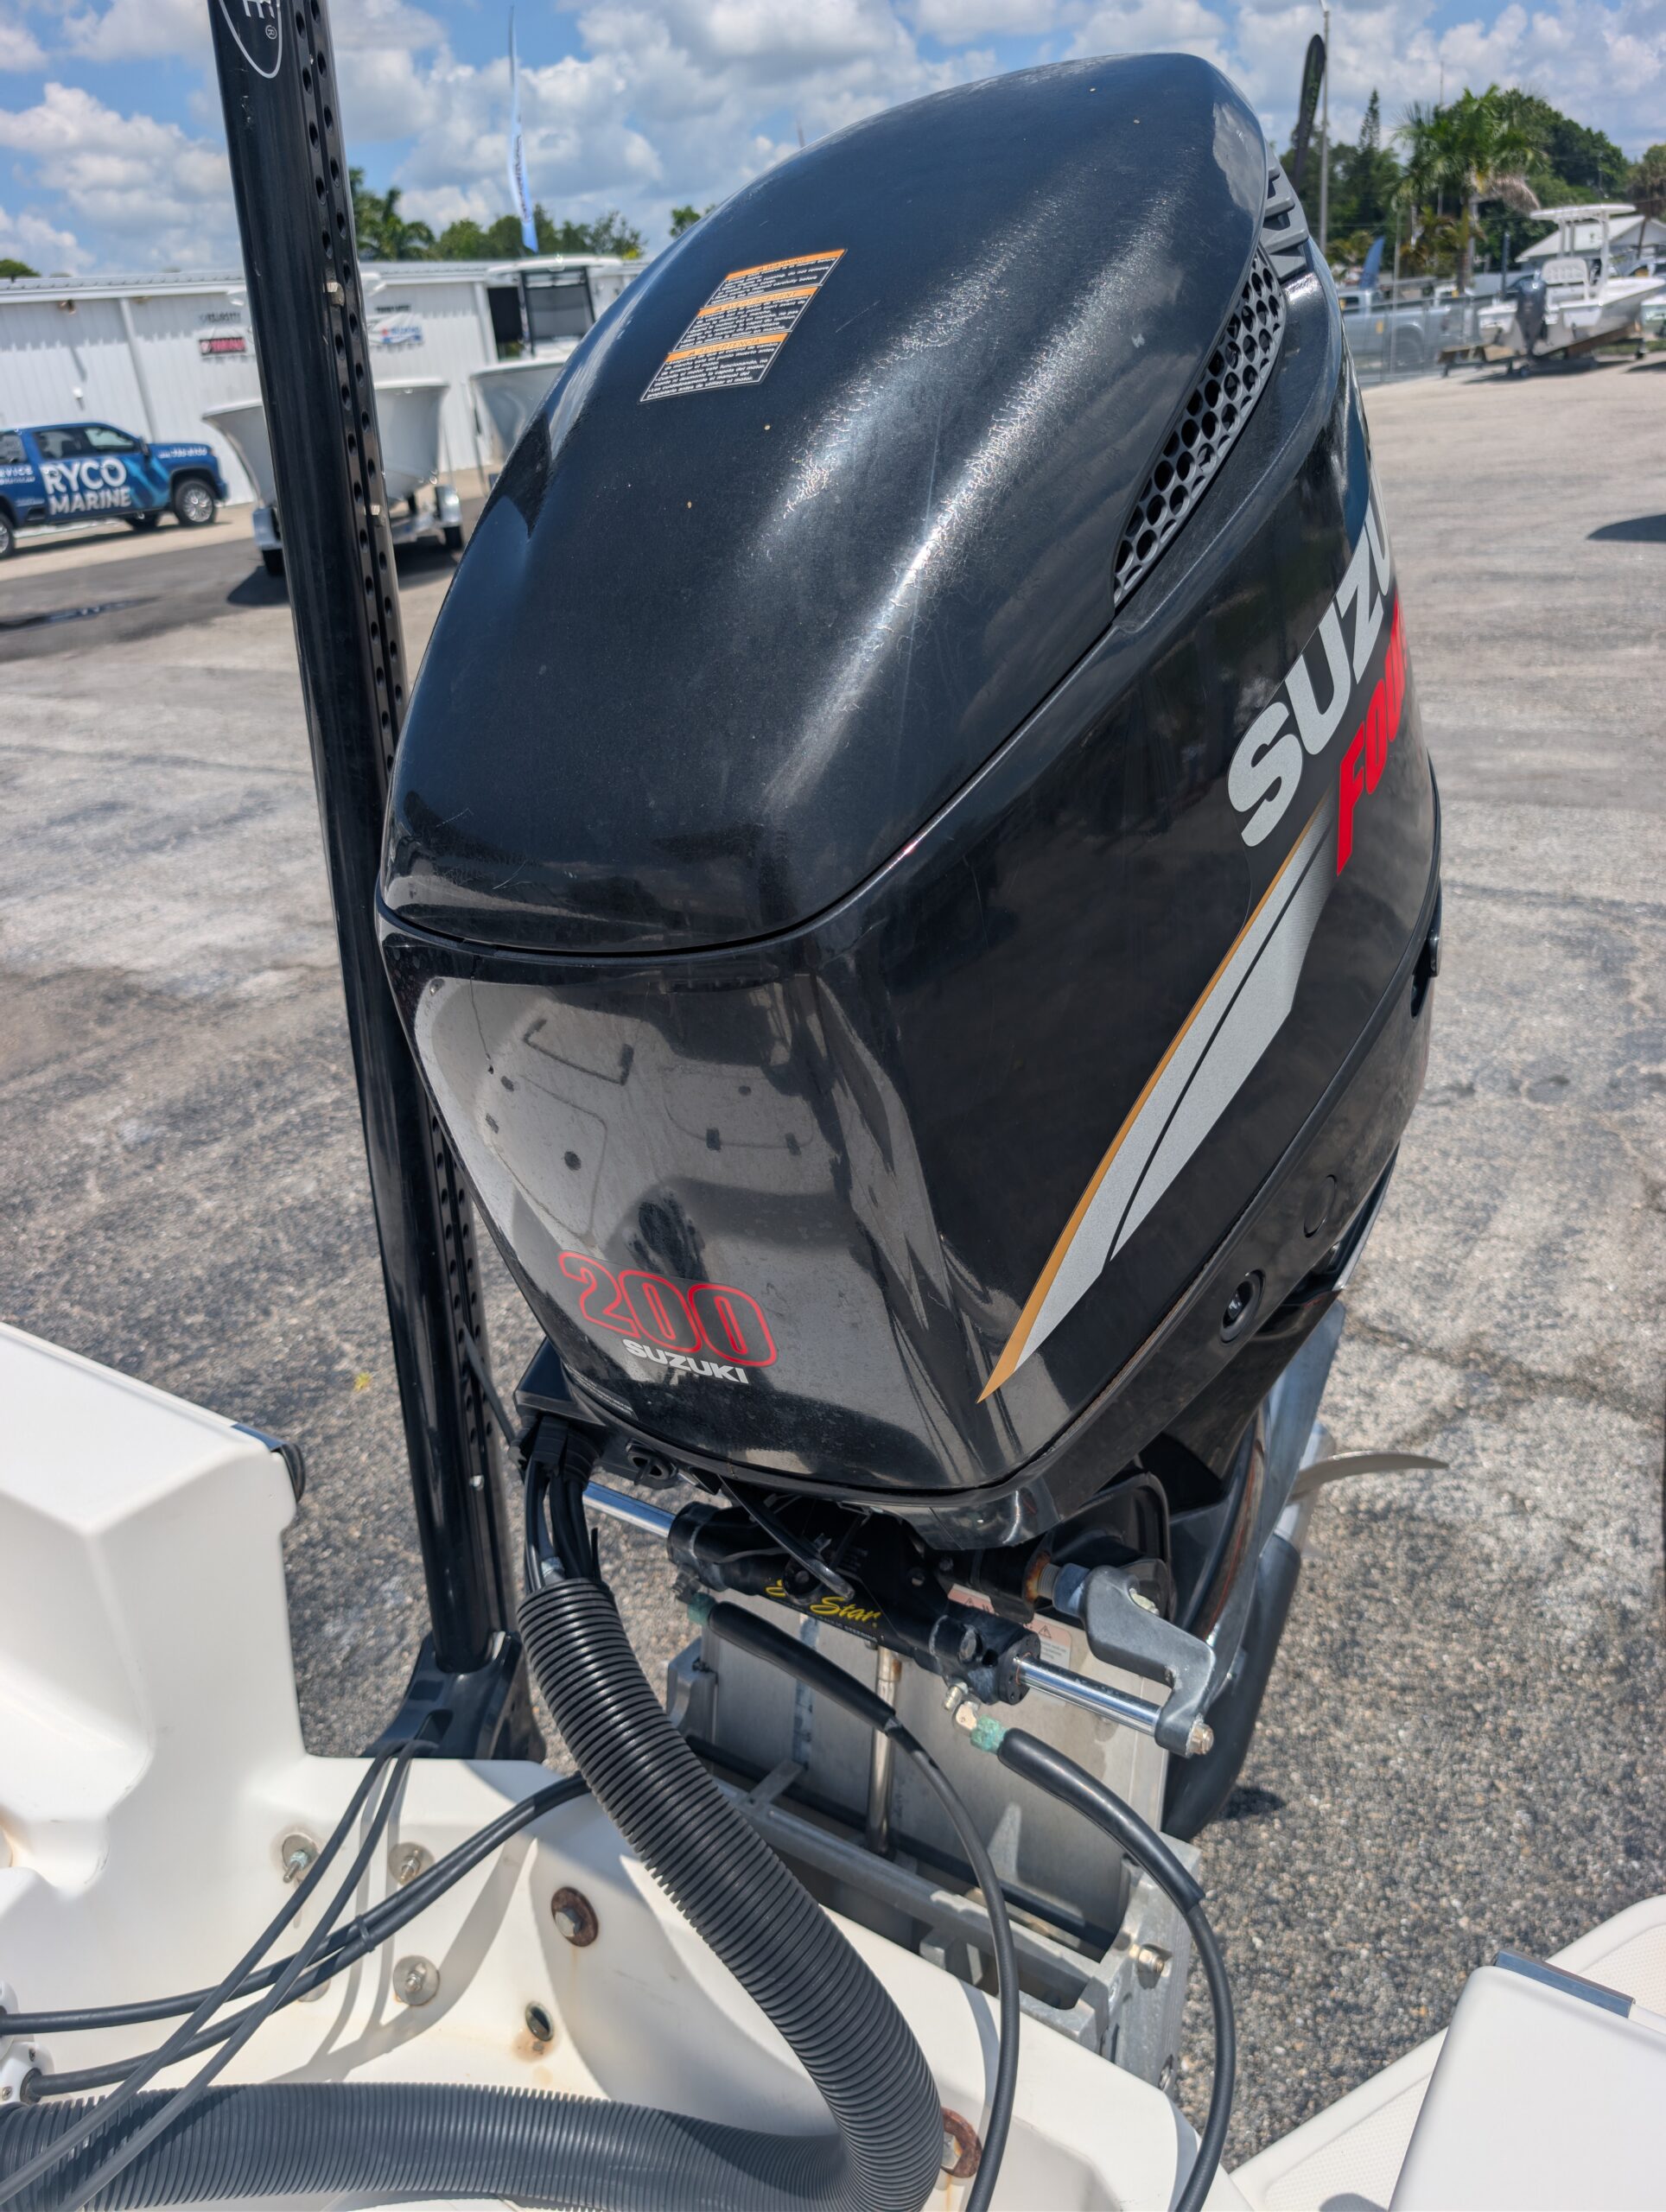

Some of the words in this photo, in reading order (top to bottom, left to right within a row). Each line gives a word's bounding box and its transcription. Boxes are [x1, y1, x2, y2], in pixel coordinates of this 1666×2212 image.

[40, 457, 127, 494] RYCO
[48, 486, 131, 515] MARINE
[558, 1250, 779, 1367] 200
[622, 1338, 749, 1384] SUZUKI
